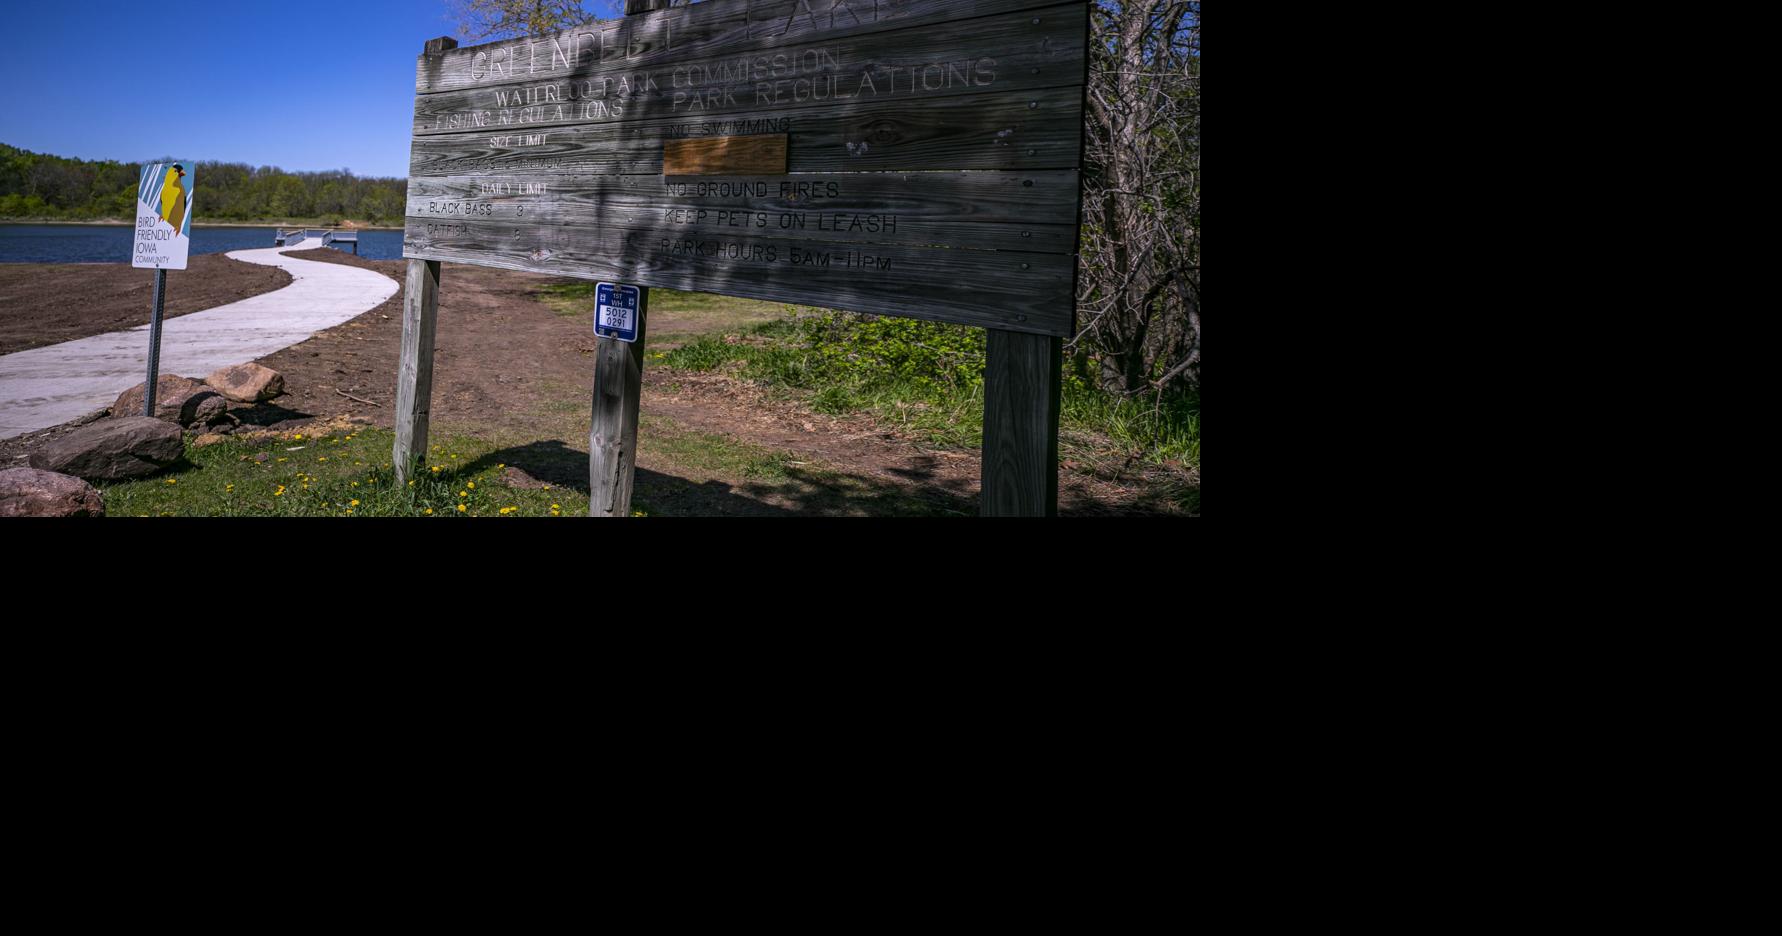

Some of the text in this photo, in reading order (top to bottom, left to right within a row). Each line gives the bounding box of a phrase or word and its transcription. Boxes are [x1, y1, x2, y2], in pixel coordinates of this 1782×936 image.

[471, 16, 682, 80] GREENBELT
[495, 42, 841, 107] WATERLOO PARK COMMISSION
[671, 56, 998, 112] PARK REGULATIONS
[435, 99, 624, 130] FISHING REGULATIONS
[670, 117, 791, 138] NO SWIMMING
[489, 133, 547, 149] SIZE LIMIT
[481, 182, 548, 195] DAILY LIMIT
[664, 181, 839, 199] NO GROUND FIRES
[429, 201, 461, 214] BLACK
[465, 203, 493, 216] BASS
[138, 217, 155, 227] BIRD
[664, 209, 898, 235] KEEP PETS ON LEASH
[137, 229, 171, 240] FRIENDLY
[136, 243, 157, 253] IOWA
[661, 238, 706, 258] PARK
[714, 244, 777, 263] HOURS
[135, 255, 169, 263] COMMUNITY
[611, 299, 623, 307] WH
[606, 307, 627, 318] 5012
[607, 317, 624, 327] 0291
